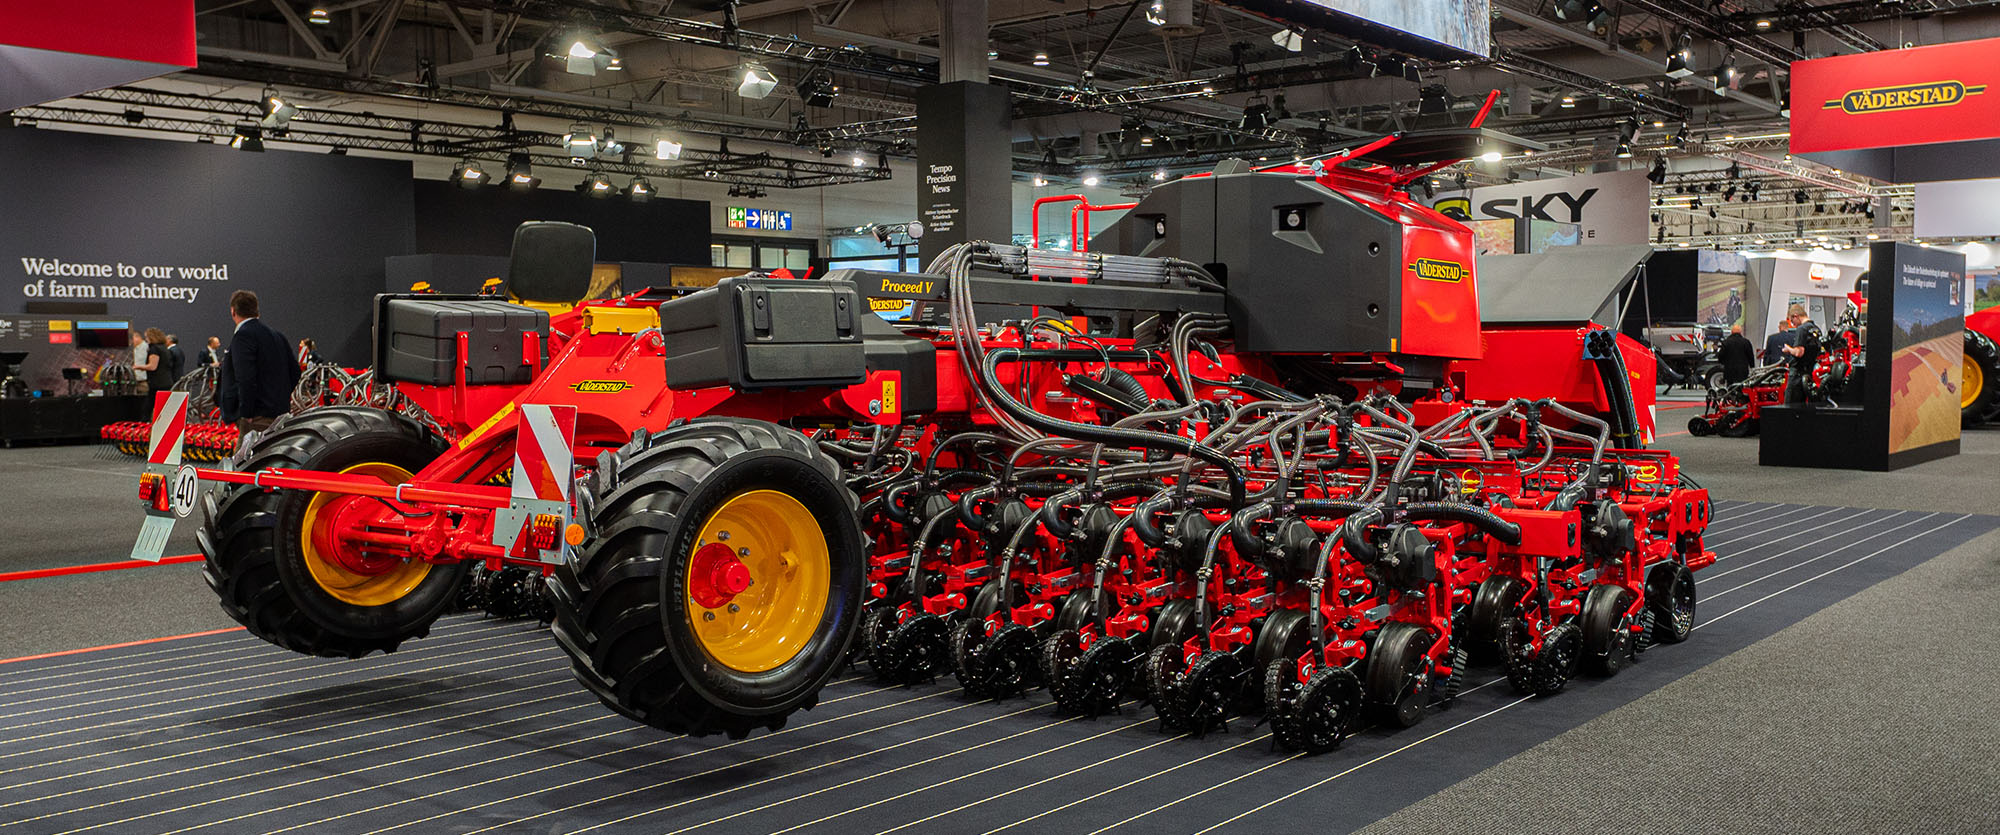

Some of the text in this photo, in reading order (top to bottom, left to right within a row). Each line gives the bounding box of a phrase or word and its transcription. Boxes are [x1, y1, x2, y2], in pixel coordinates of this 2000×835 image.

[1850, 86, 1957, 110] VÄDERSTAD
[926, 174, 957, 184] Precision
[930, 164, 953, 174] Tempo
[932, 185, 951, 194] News
[1481, 188, 1599, 223] SKY
[21, 257, 229, 281] Welcome to our world
[1418, 260, 1460, 280] VÄDERSTAD
[23, 279, 199, 303] of farm machinery
[881, 279, 934, 294] Proceed V
[176, 474, 195, 508] 40
